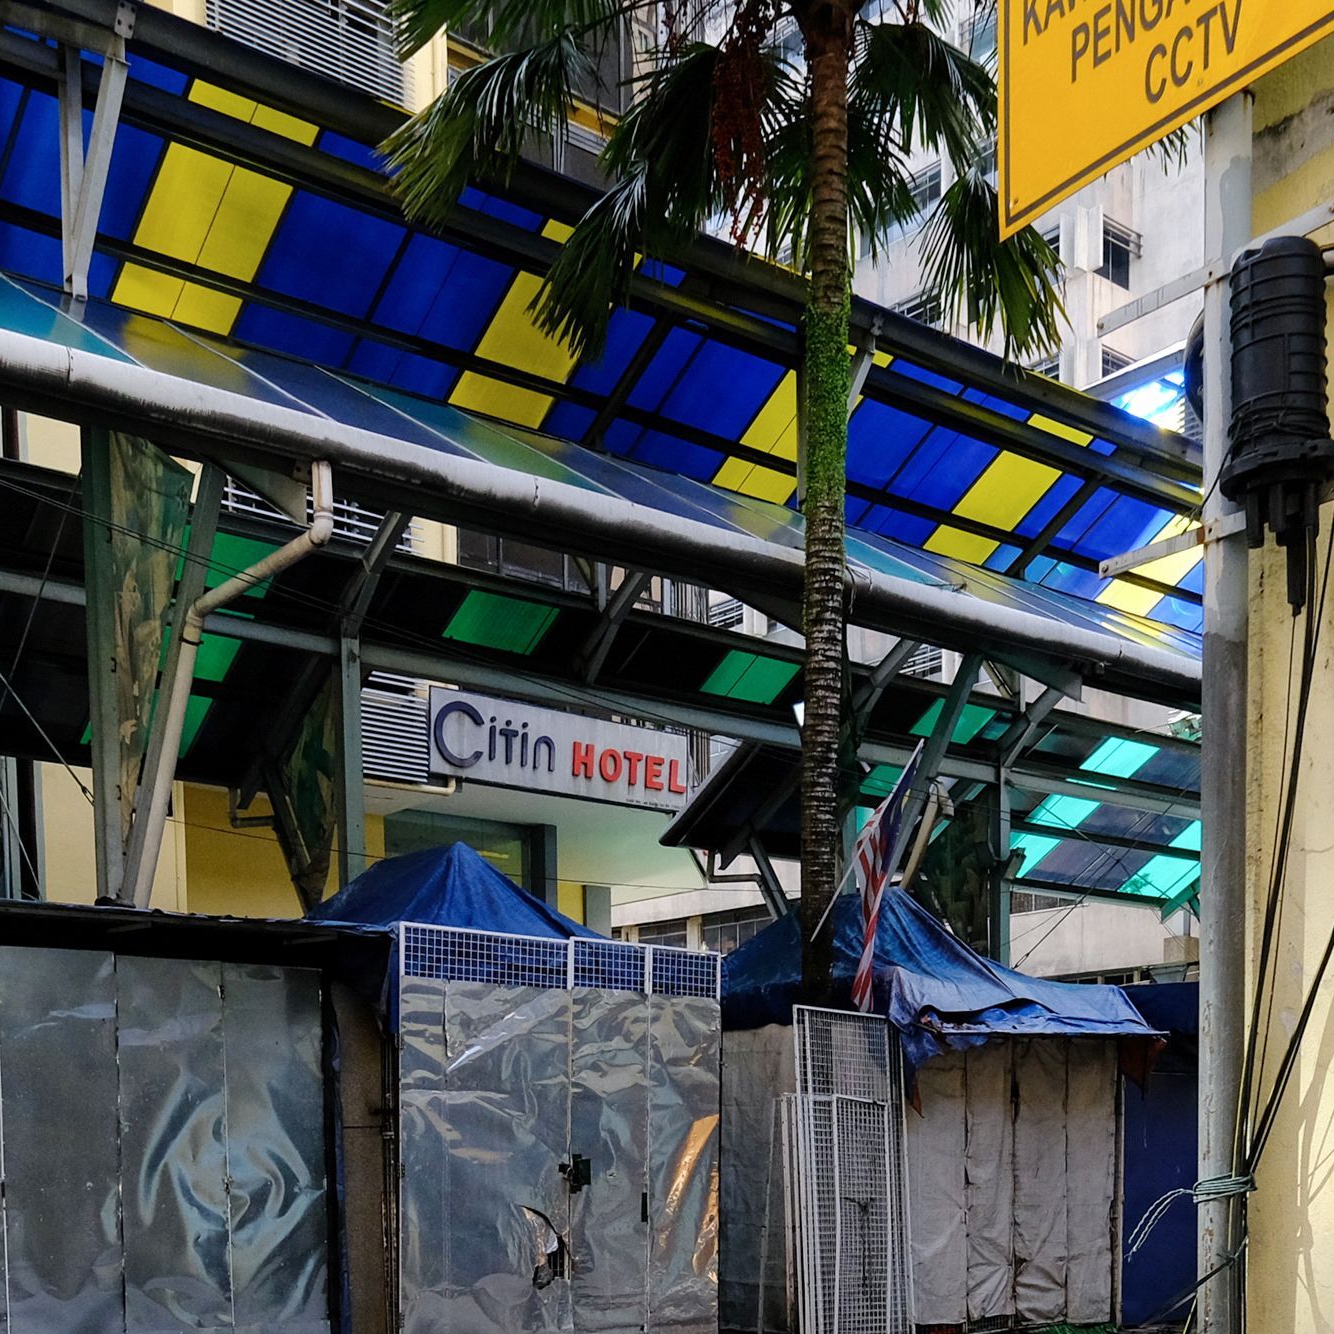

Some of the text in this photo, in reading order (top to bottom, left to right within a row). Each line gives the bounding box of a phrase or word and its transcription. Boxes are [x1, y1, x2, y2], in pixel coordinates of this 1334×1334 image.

[1145, 0, 1242, 103] CCTV
[434, 701, 686, 794] Citin HOTEL
